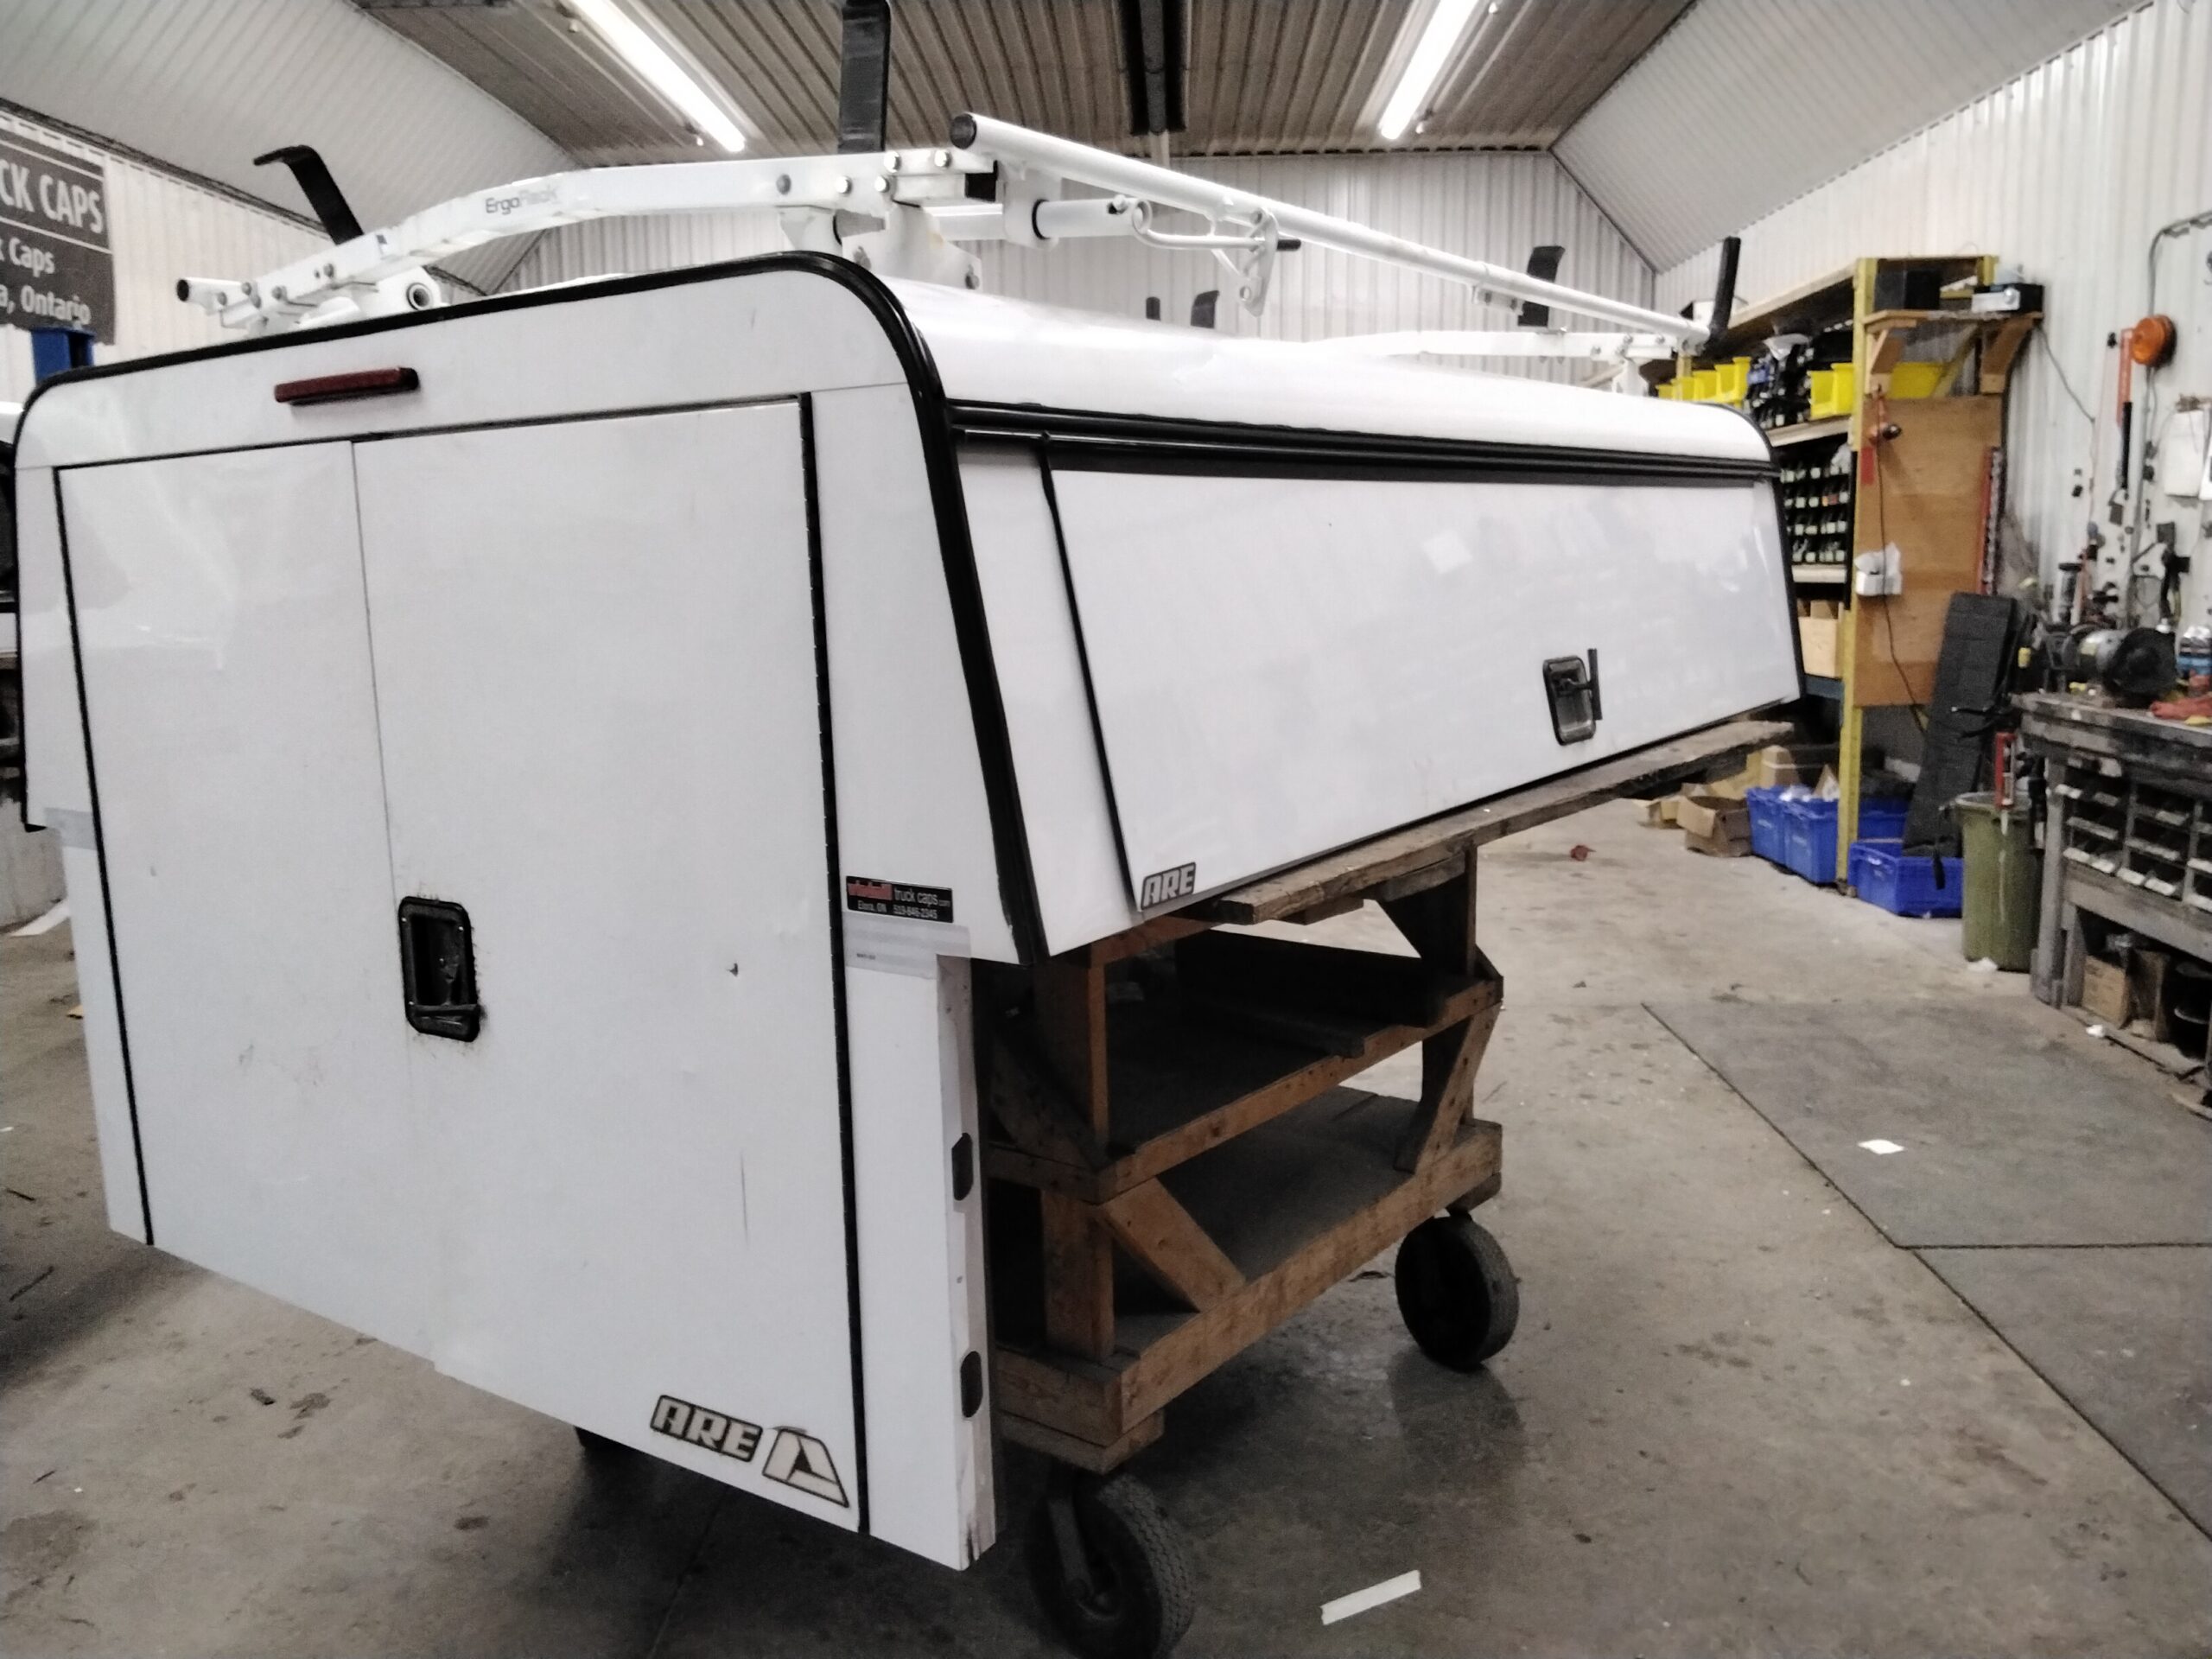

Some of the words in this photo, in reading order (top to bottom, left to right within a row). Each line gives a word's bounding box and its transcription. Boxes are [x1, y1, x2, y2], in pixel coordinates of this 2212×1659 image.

[39, 174, 104, 234] CAPS
[9, 237, 55, 277] Caps
[21, 285, 92, 325] Ontario
[894, 887, 916, 903] truck
[1141, 862, 1196, 910] ARE
[651, 1395, 762, 1461] ARE
